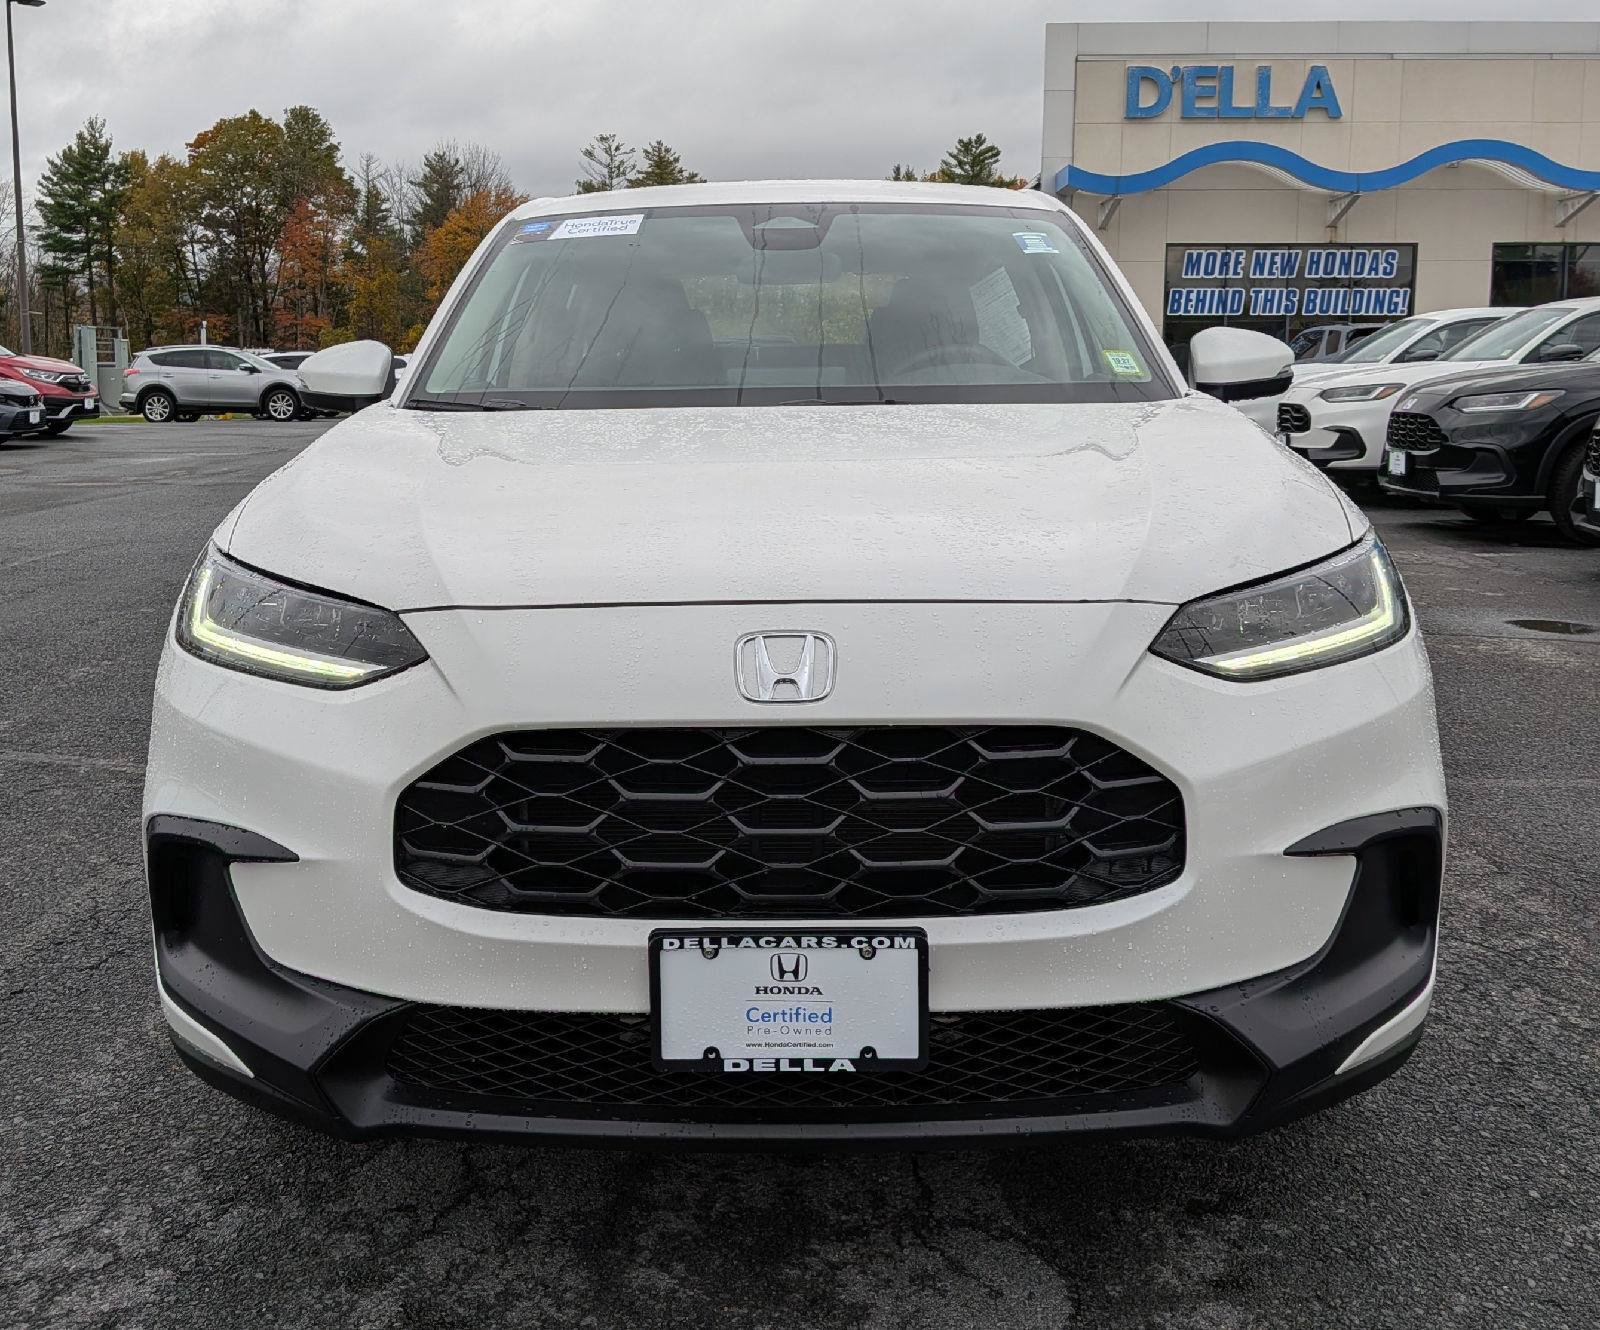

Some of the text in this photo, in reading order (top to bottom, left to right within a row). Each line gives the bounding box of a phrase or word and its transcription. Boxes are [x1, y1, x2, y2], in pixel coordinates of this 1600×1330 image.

[1124, 64, 1342, 119] D'ELLA
[564, 219, 637, 230] HondaTrue
[567, 224, 628, 235] Certified
[1182, 249, 1398, 279] MORE NEW HONDAS
[1167, 288, 1410, 316] BEHIND THIS BUILDING!
[662, 936, 916, 950] DELLACARS.COM
[754, 985, 824, 996] HONDA
[745, 1006, 833, 1024] Certified
[747, 1025, 832, 1036] Pre-Owned
[745, 1041, 834, 1049] www.HondaCertified.com
[723, 1058, 857, 1073] DELLA
